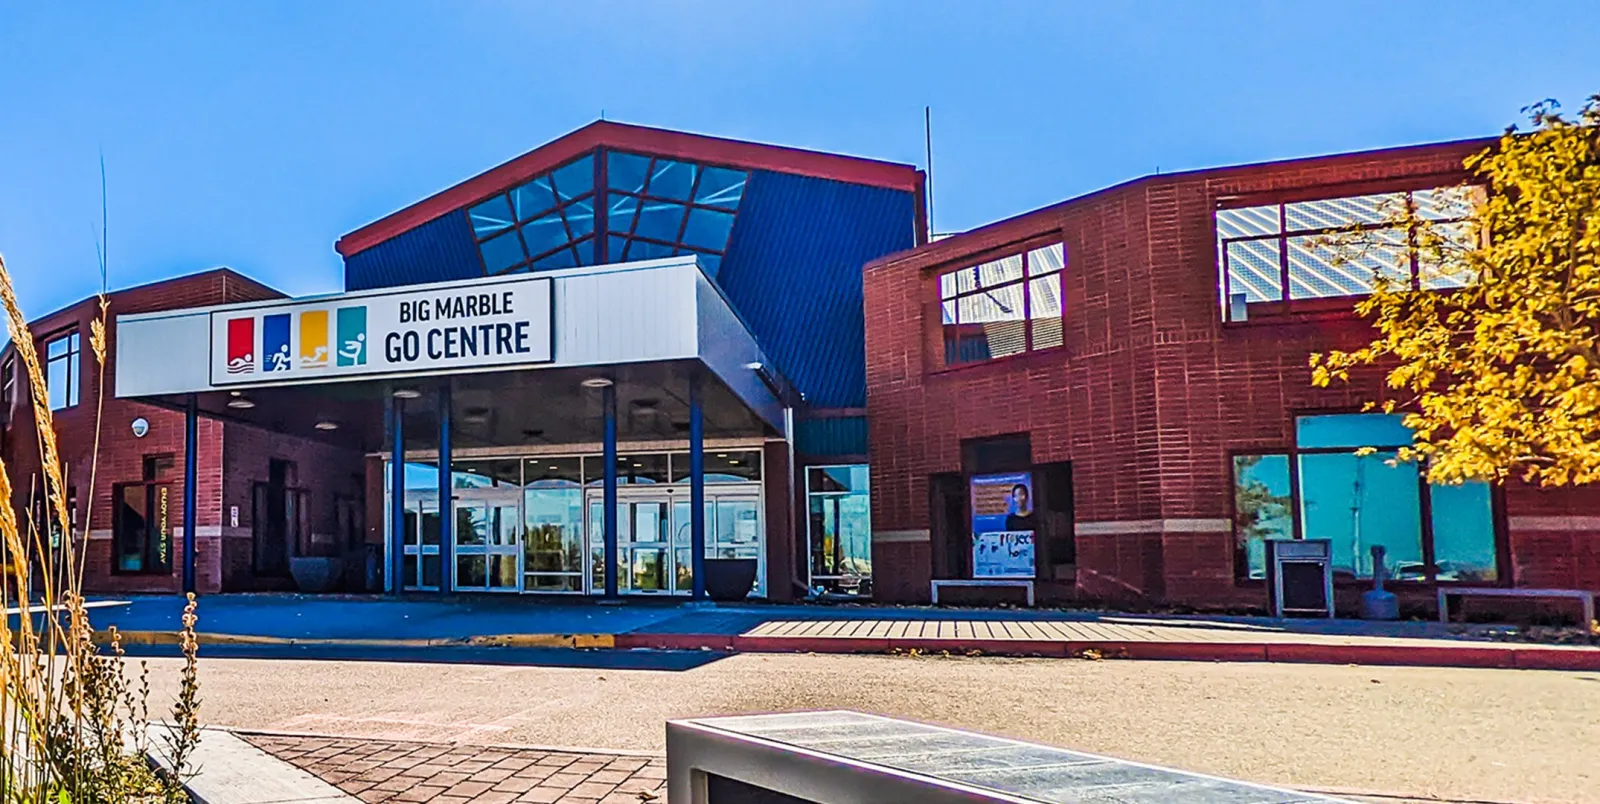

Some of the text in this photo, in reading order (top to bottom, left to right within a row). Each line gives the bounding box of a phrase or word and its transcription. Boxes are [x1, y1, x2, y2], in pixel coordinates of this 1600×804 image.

[400, 292, 513, 323] BIG MARBLE
[385, 321, 531, 363] GO CENTRE
